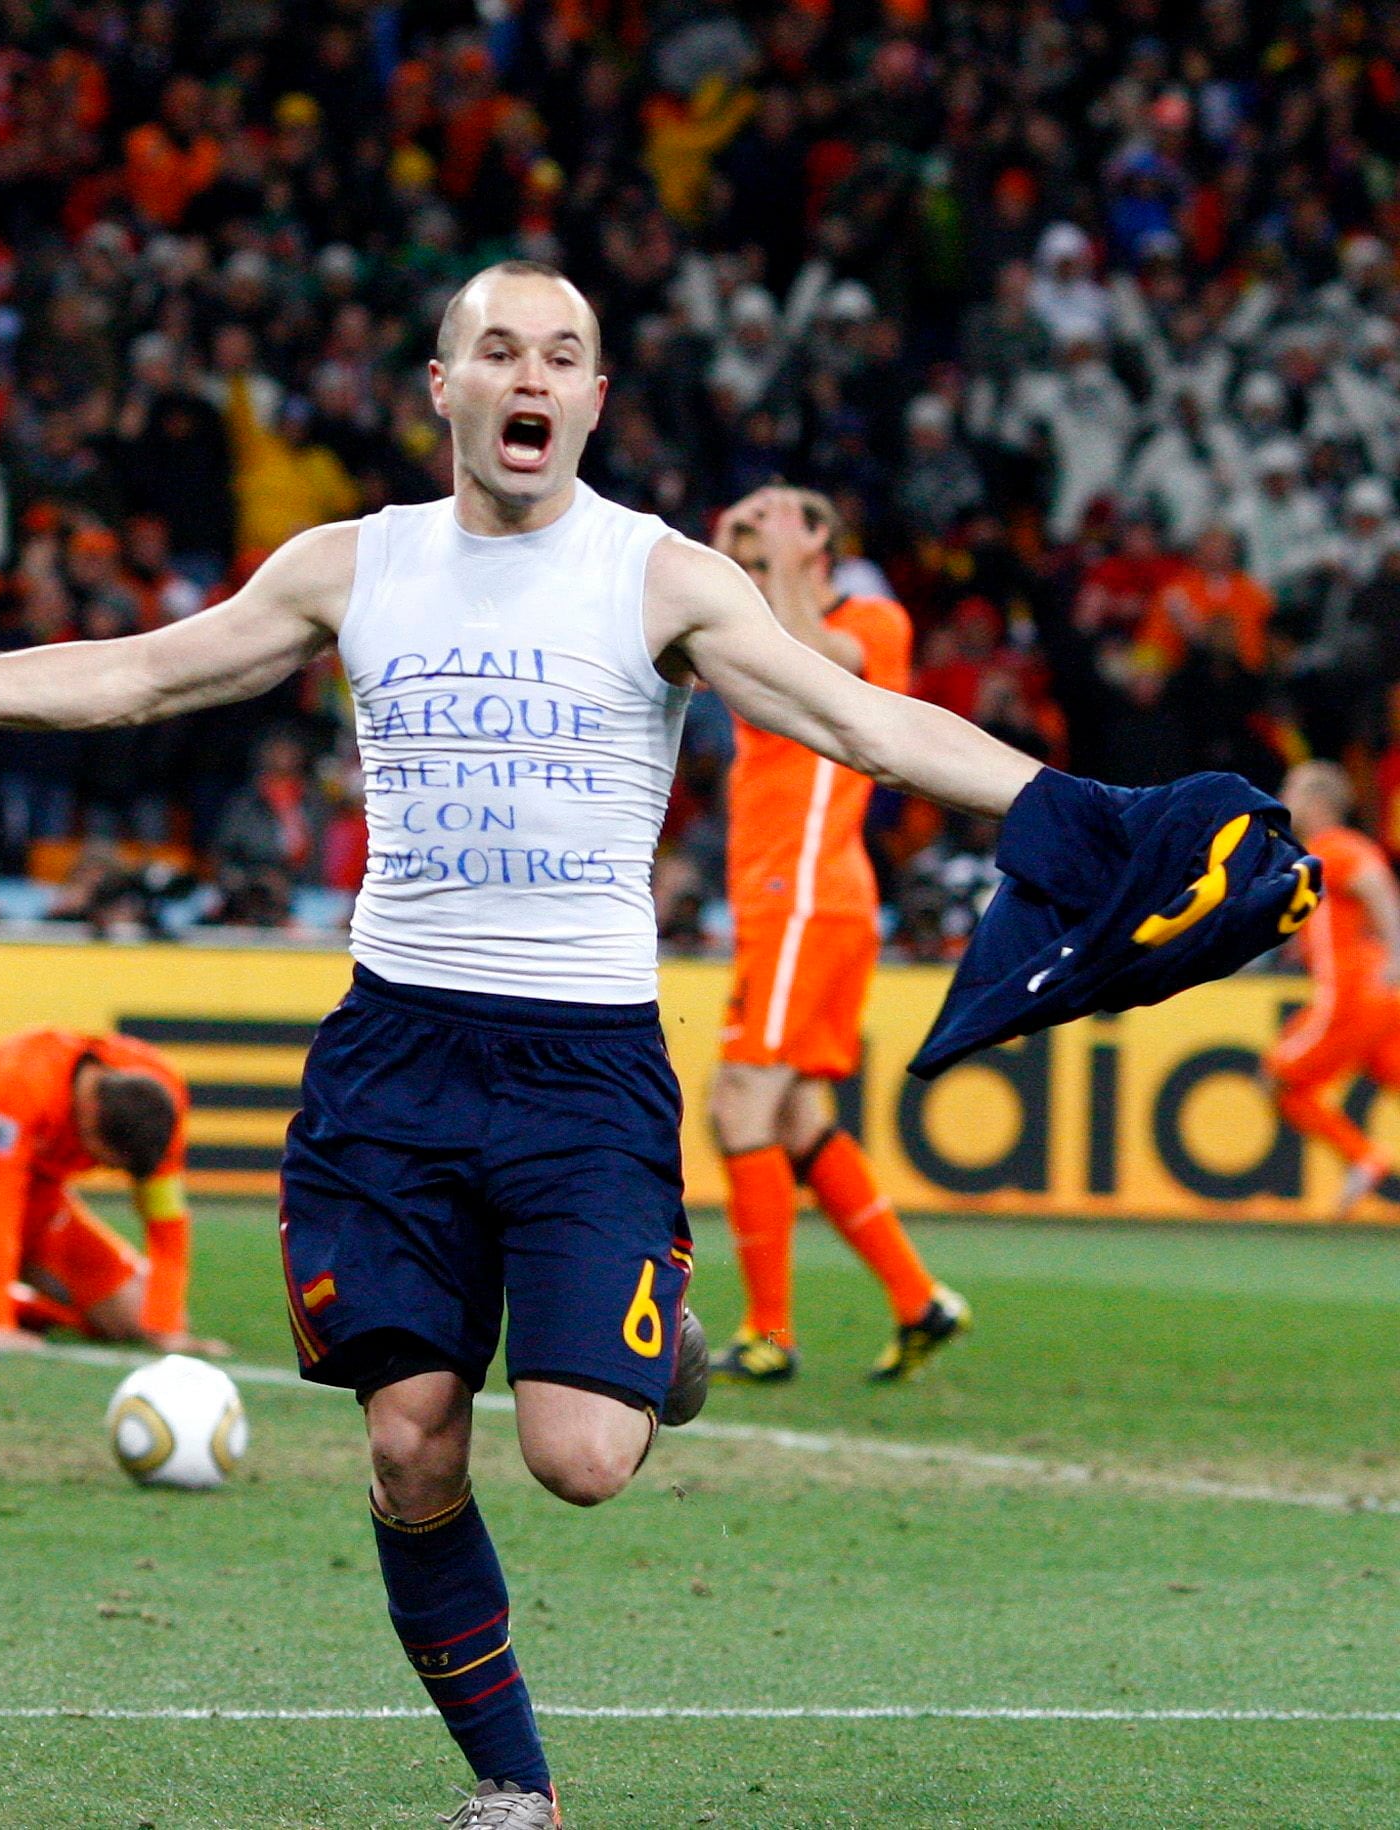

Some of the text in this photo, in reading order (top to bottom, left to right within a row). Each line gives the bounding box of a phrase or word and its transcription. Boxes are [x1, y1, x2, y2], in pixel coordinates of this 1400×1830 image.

[380, 648, 545, 688] DANI
[376, 759, 618, 795] SIEMPRE
[403, 801, 516, 834] CON
[381, 845, 616, 886] NOSOTROS
[622, 1258, 663, 1359] 6
